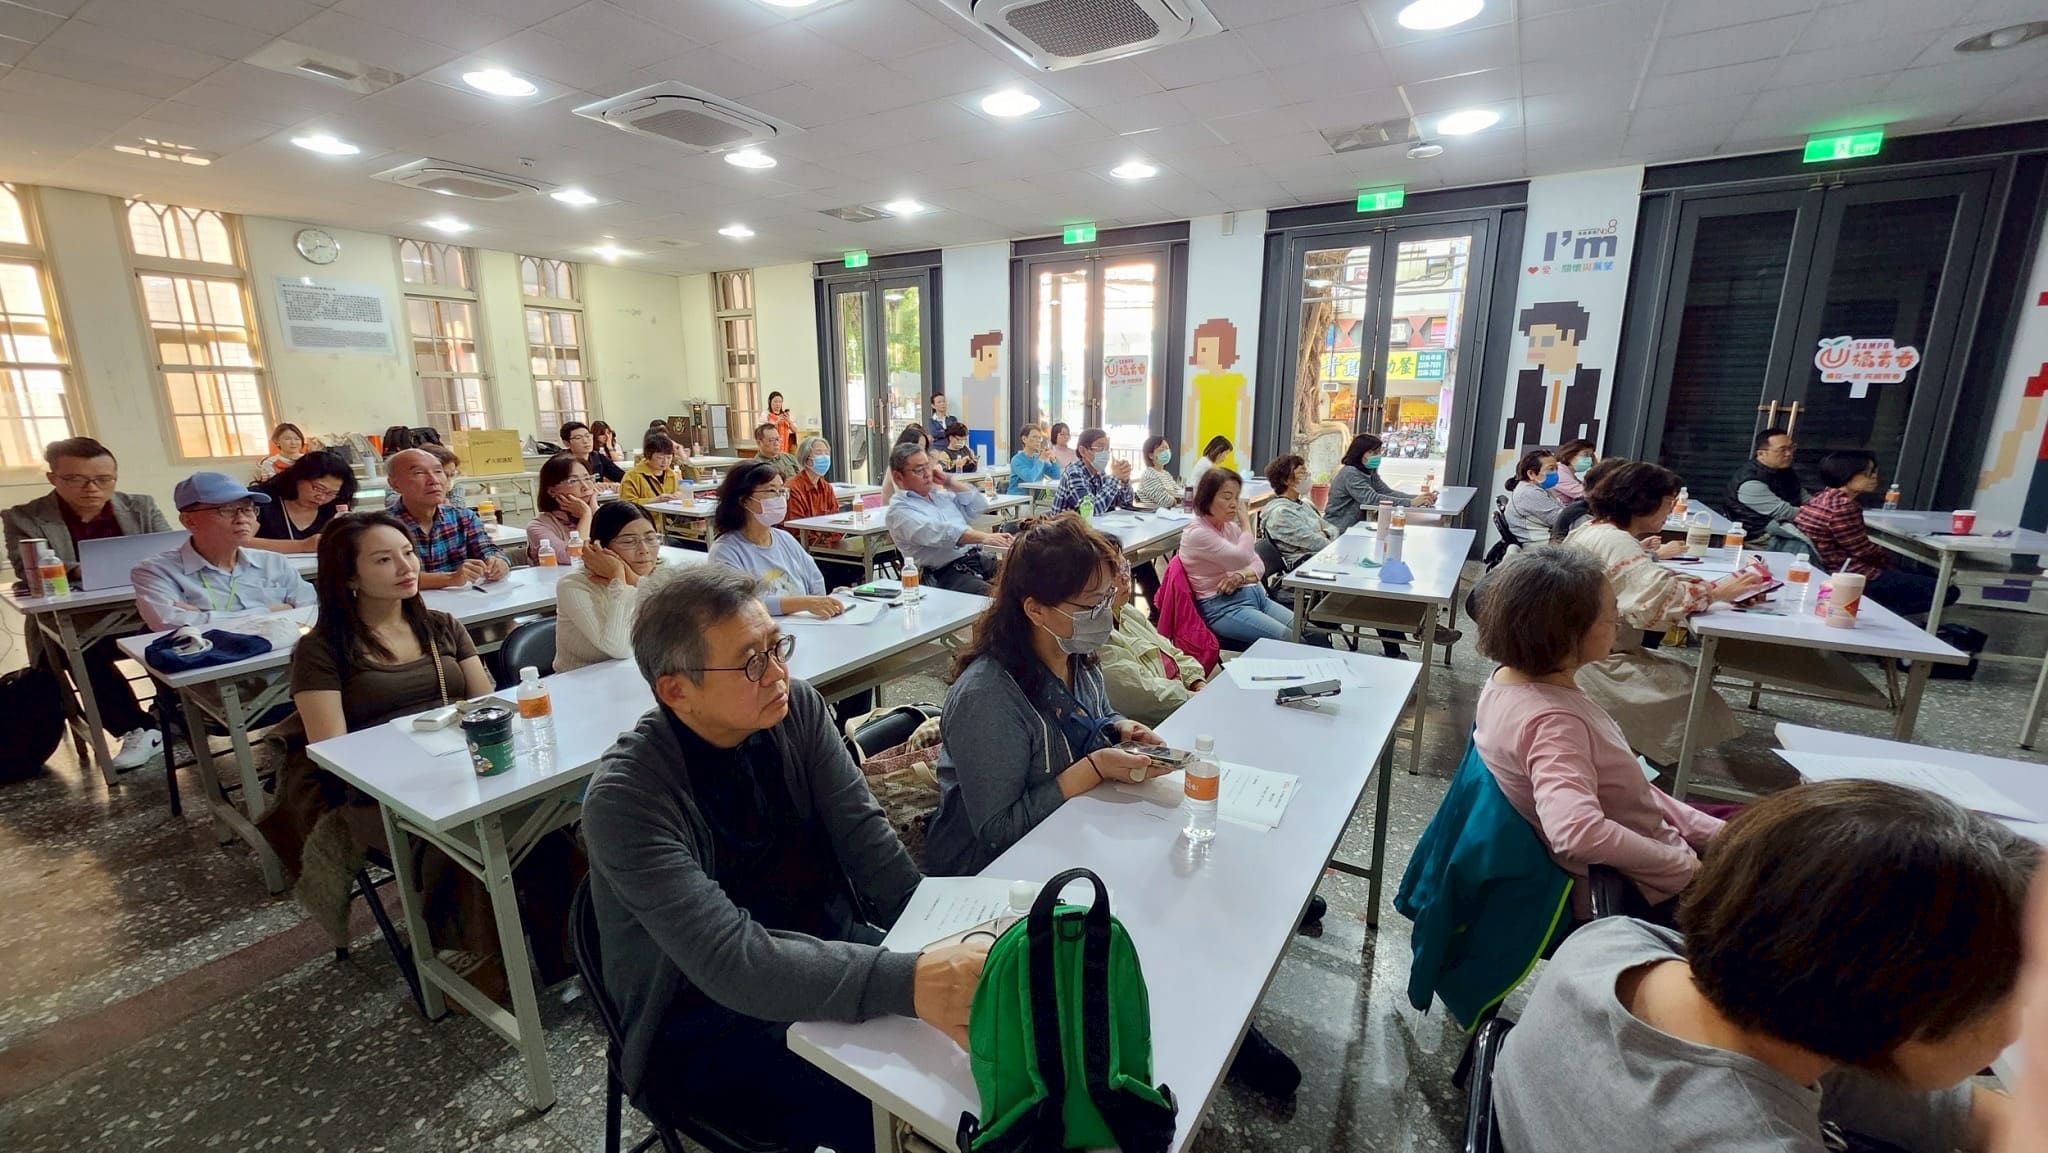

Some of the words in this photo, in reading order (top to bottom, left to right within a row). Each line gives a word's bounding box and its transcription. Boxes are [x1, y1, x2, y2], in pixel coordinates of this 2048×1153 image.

[1544, 231, 1617, 261] I'm
[1855, 342, 1889, 350] SAMPO
[1853, 350, 1914, 368] 橘青春
